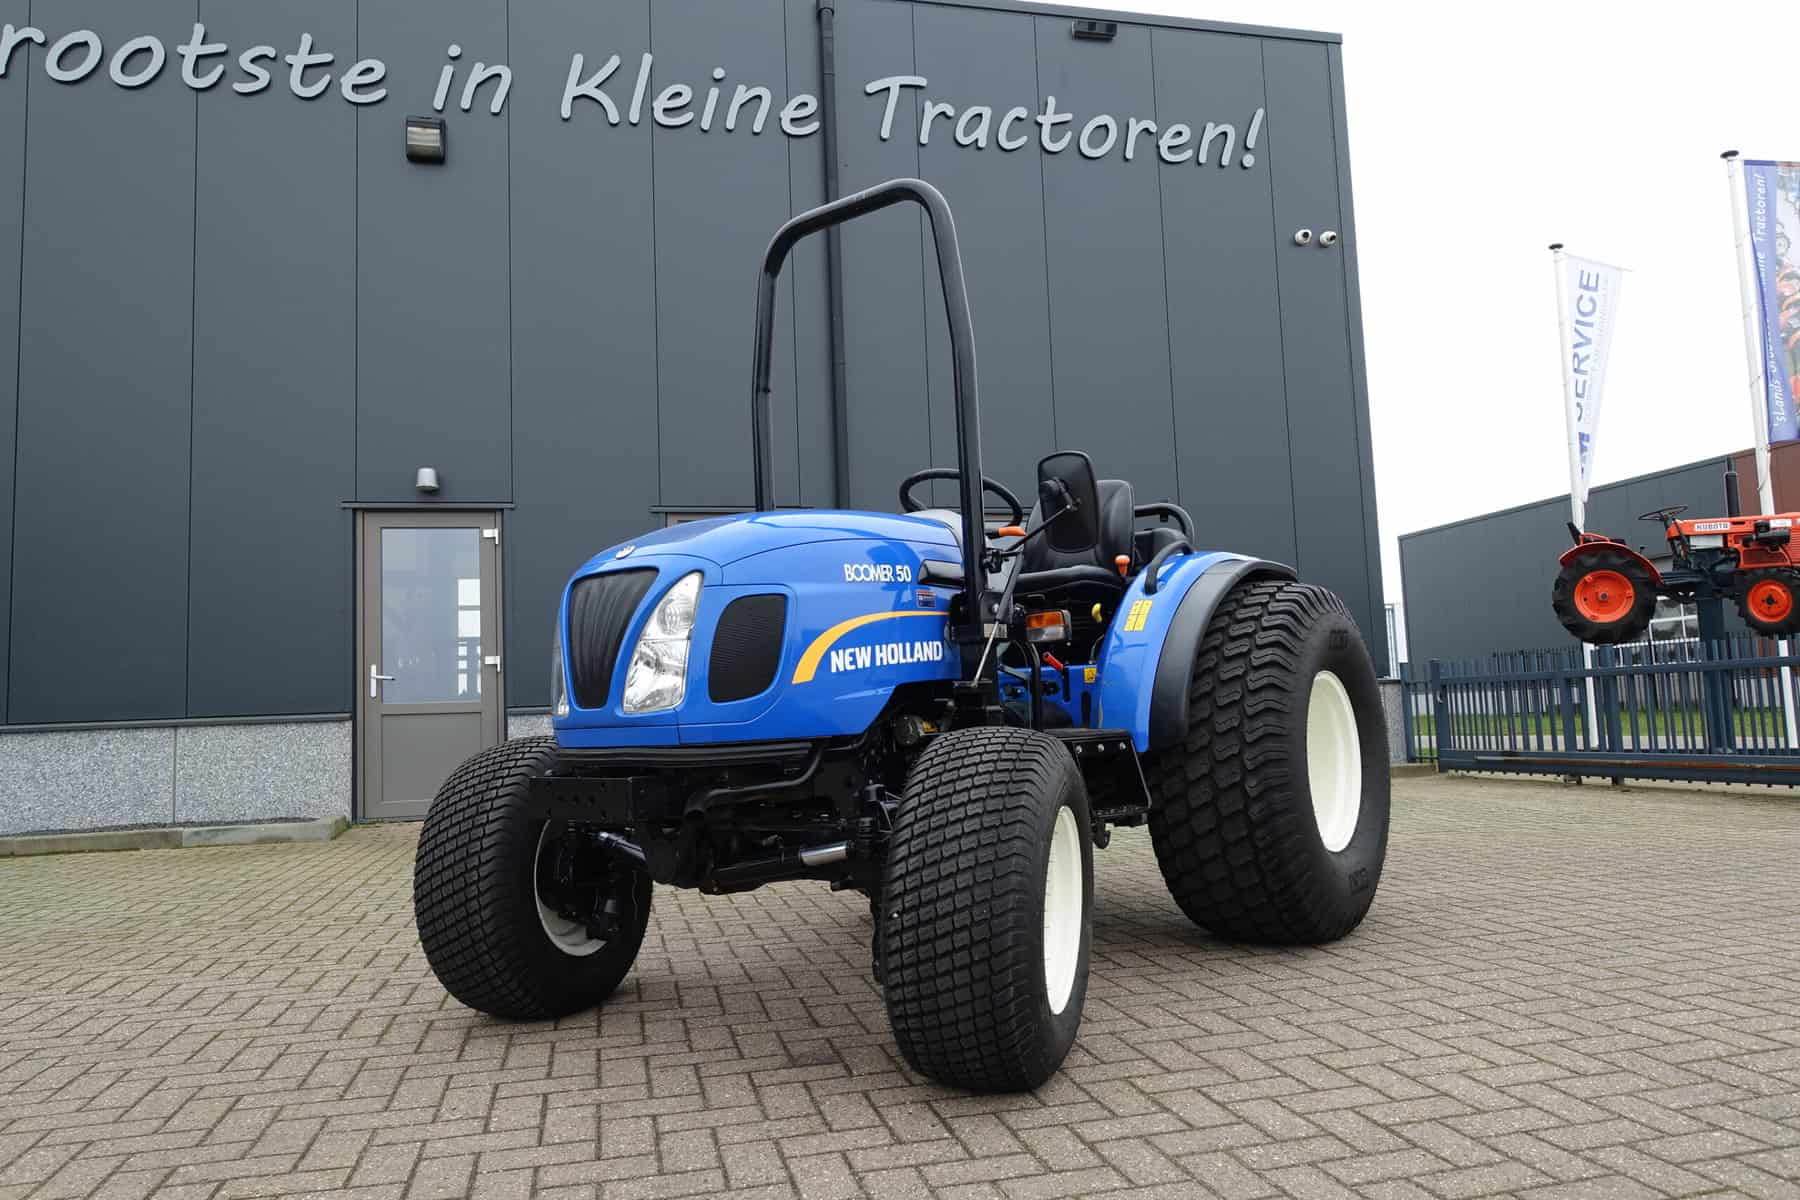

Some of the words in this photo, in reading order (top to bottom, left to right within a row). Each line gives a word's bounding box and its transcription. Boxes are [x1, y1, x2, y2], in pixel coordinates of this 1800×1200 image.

[432, 44, 512, 114] in
[560, 52, 819, 136] Kleine
[865, 75, 1265, 169] Tractoren!
[843, 563, 895, 583] BOOMER
[896, 565, 912, 583] 50
[830, 645, 872, 673] NEW
[874, 641, 943, 666] HOLLAND
